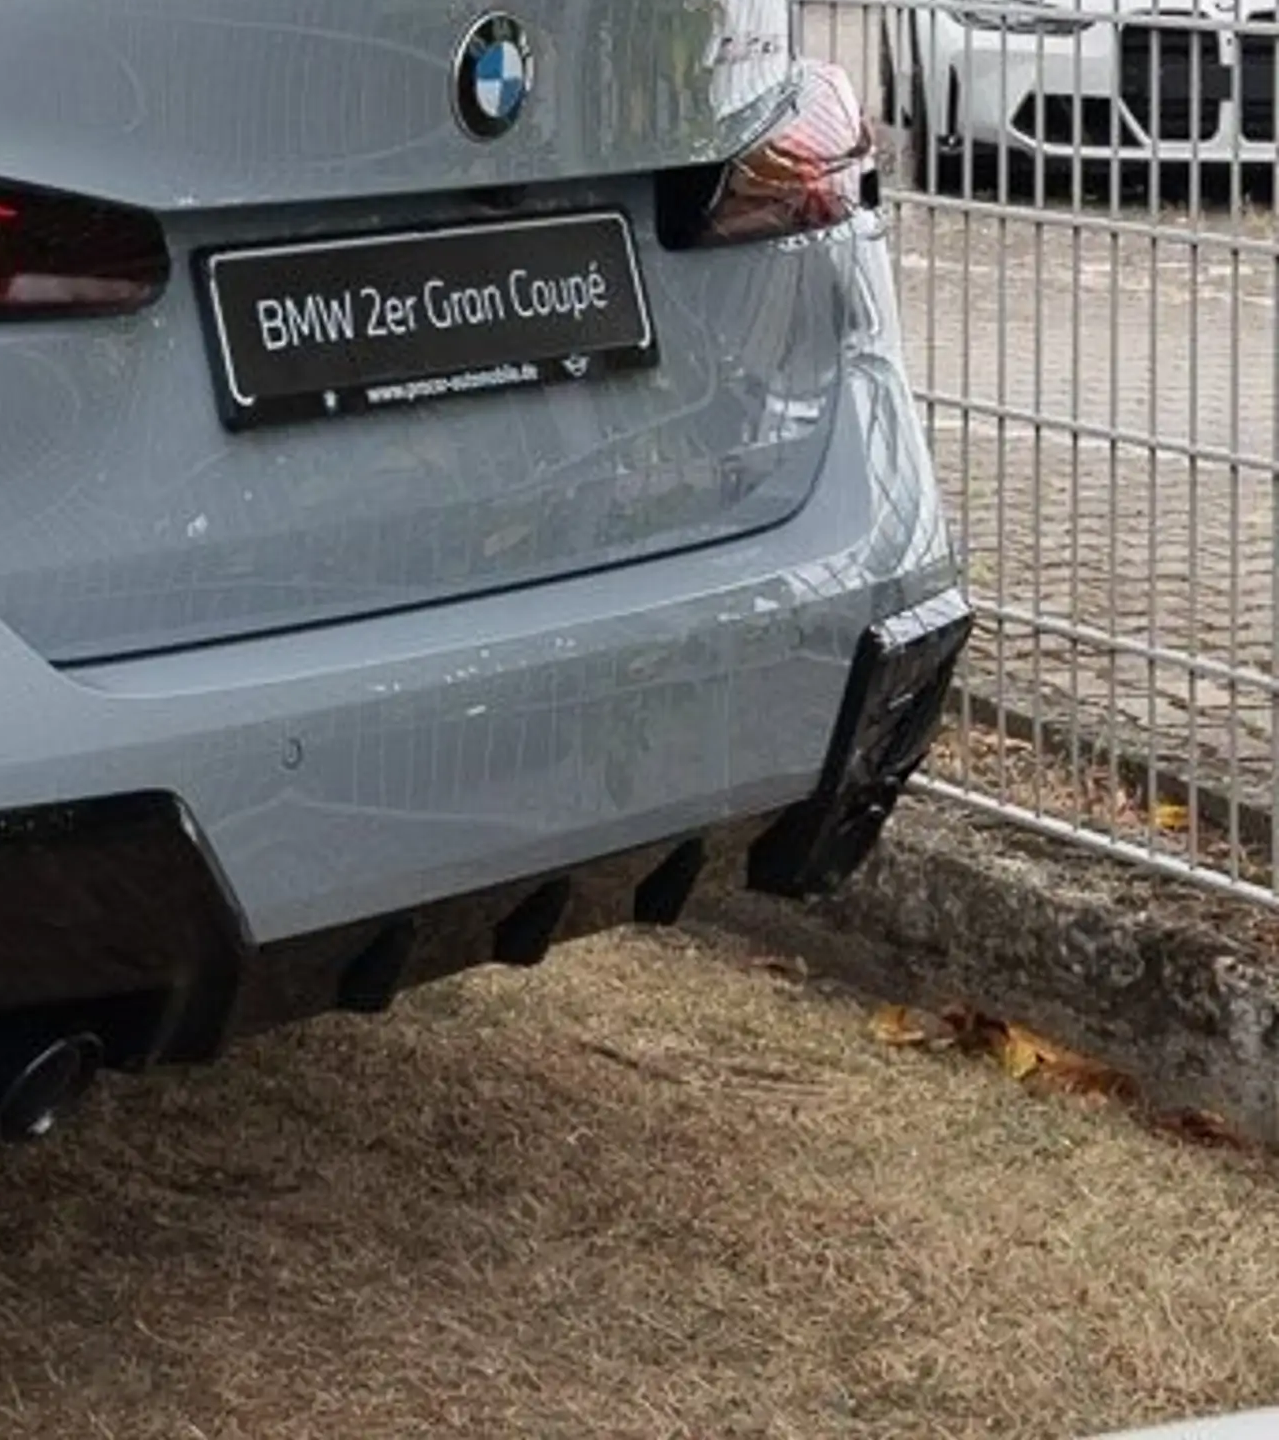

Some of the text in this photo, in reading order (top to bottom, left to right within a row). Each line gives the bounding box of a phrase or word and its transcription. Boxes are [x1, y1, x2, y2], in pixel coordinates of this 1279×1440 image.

[256, 260, 609, 352] BMW 2er Gran Coupé
